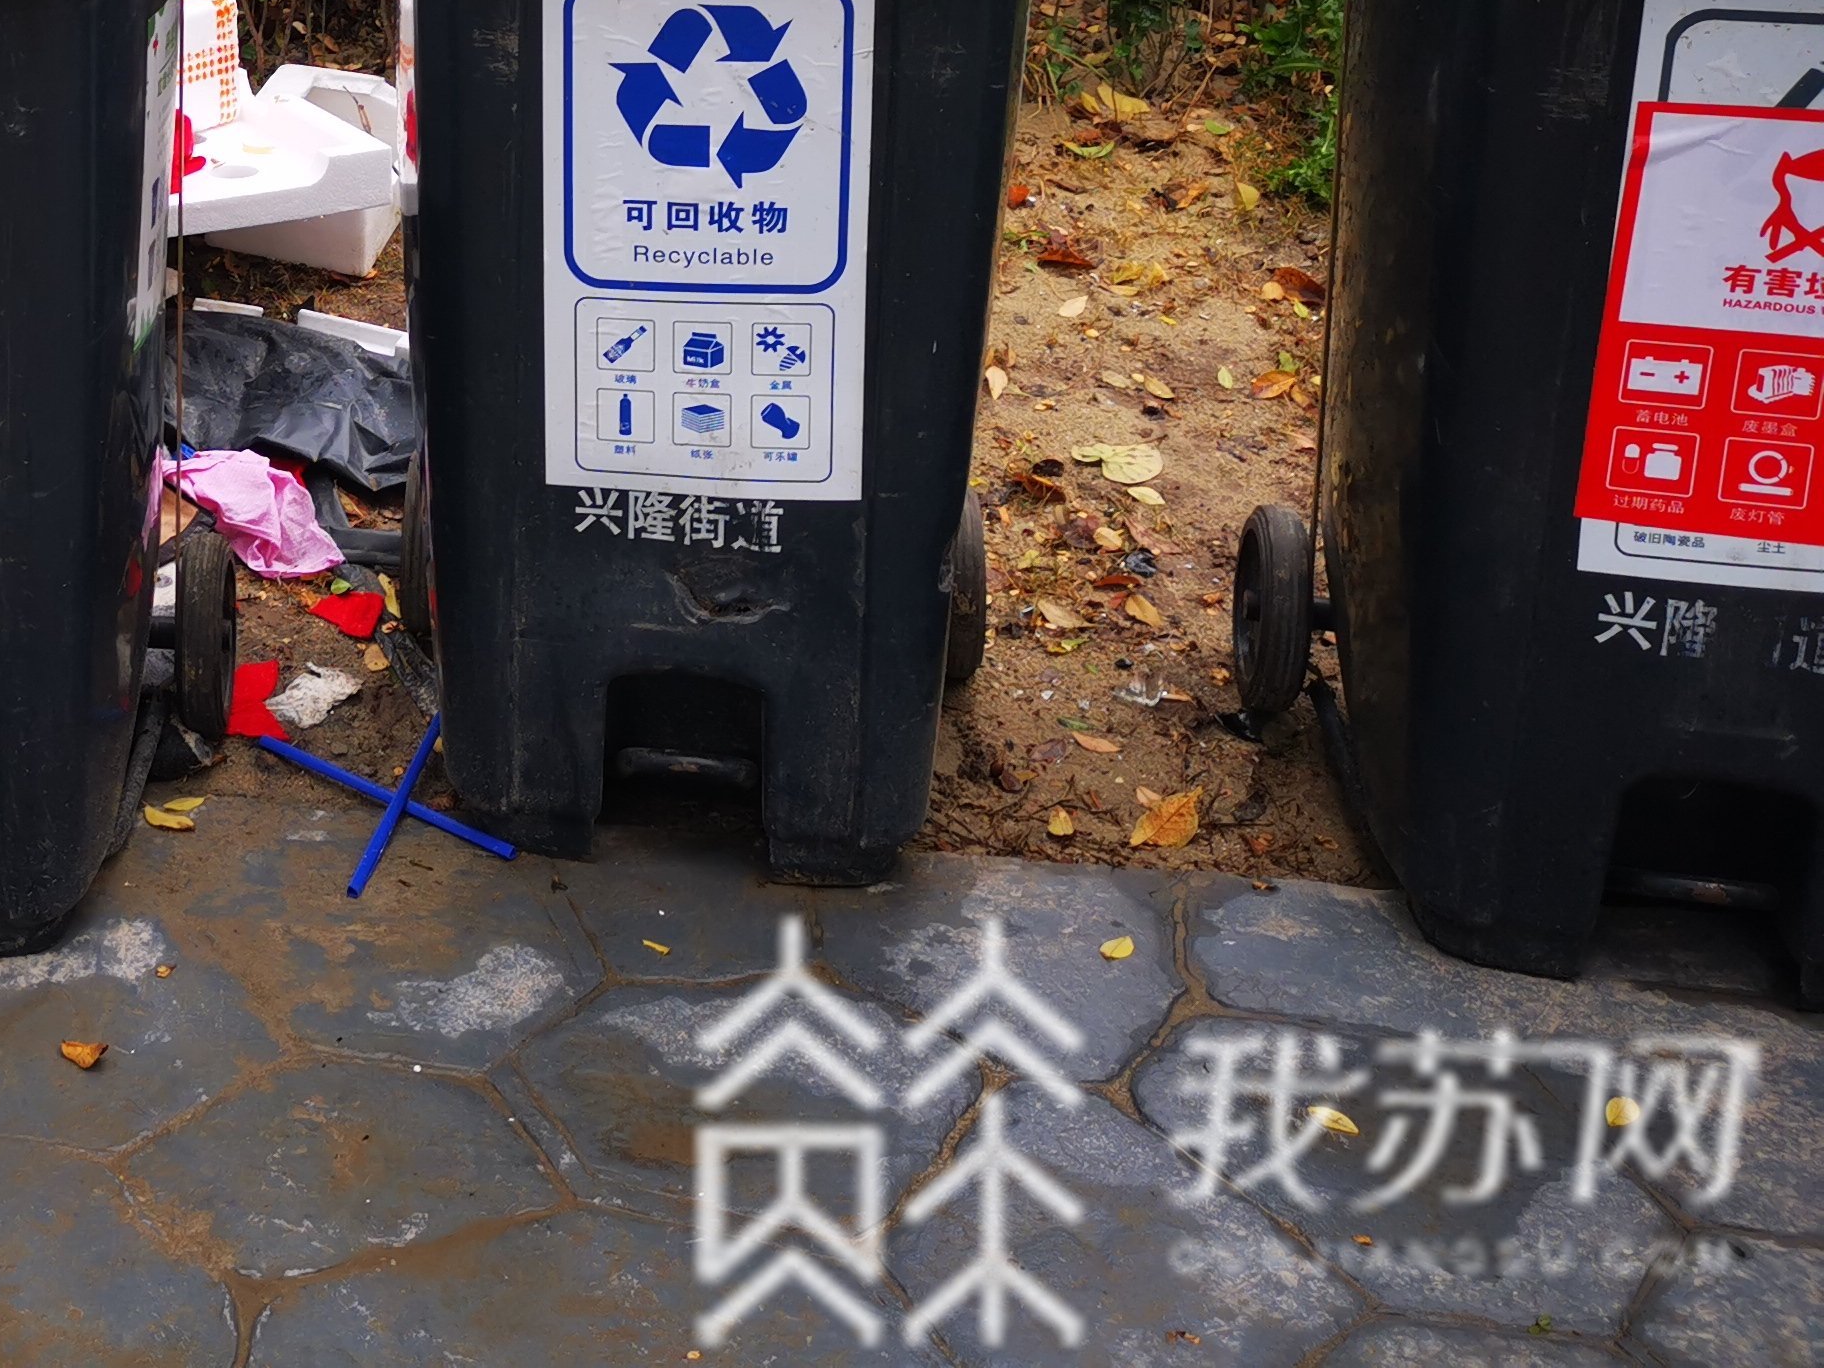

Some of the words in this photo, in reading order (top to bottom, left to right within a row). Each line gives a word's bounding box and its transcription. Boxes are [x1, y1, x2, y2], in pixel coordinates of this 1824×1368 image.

[623, 199, 788, 234] 可回收物
[633, 245, 774, 269] Recyclable
[1722, 298, 1816, 314] HAZARDOUS
[685, 378, 720, 389] 牛奶盒
[770, 380, 793, 391] 金属
[1636, 409, 1689, 427] 蓄电池
[1742, 420, 1798, 437] 废墨盒
[614, 445, 636, 455] 塑料
[690, 449, 714, 460] 纸张
[763, 451, 798, 462] 可乐罐
[1613, 495, 1685, 514] 过期药品
[574, 486, 784, 553] 兴隆街道
[1729, 507, 1785, 526] 废灯管
[1633, 532, 1706, 549] 破旧陶瓷品
[1757, 542, 1786, 554] 尘土
